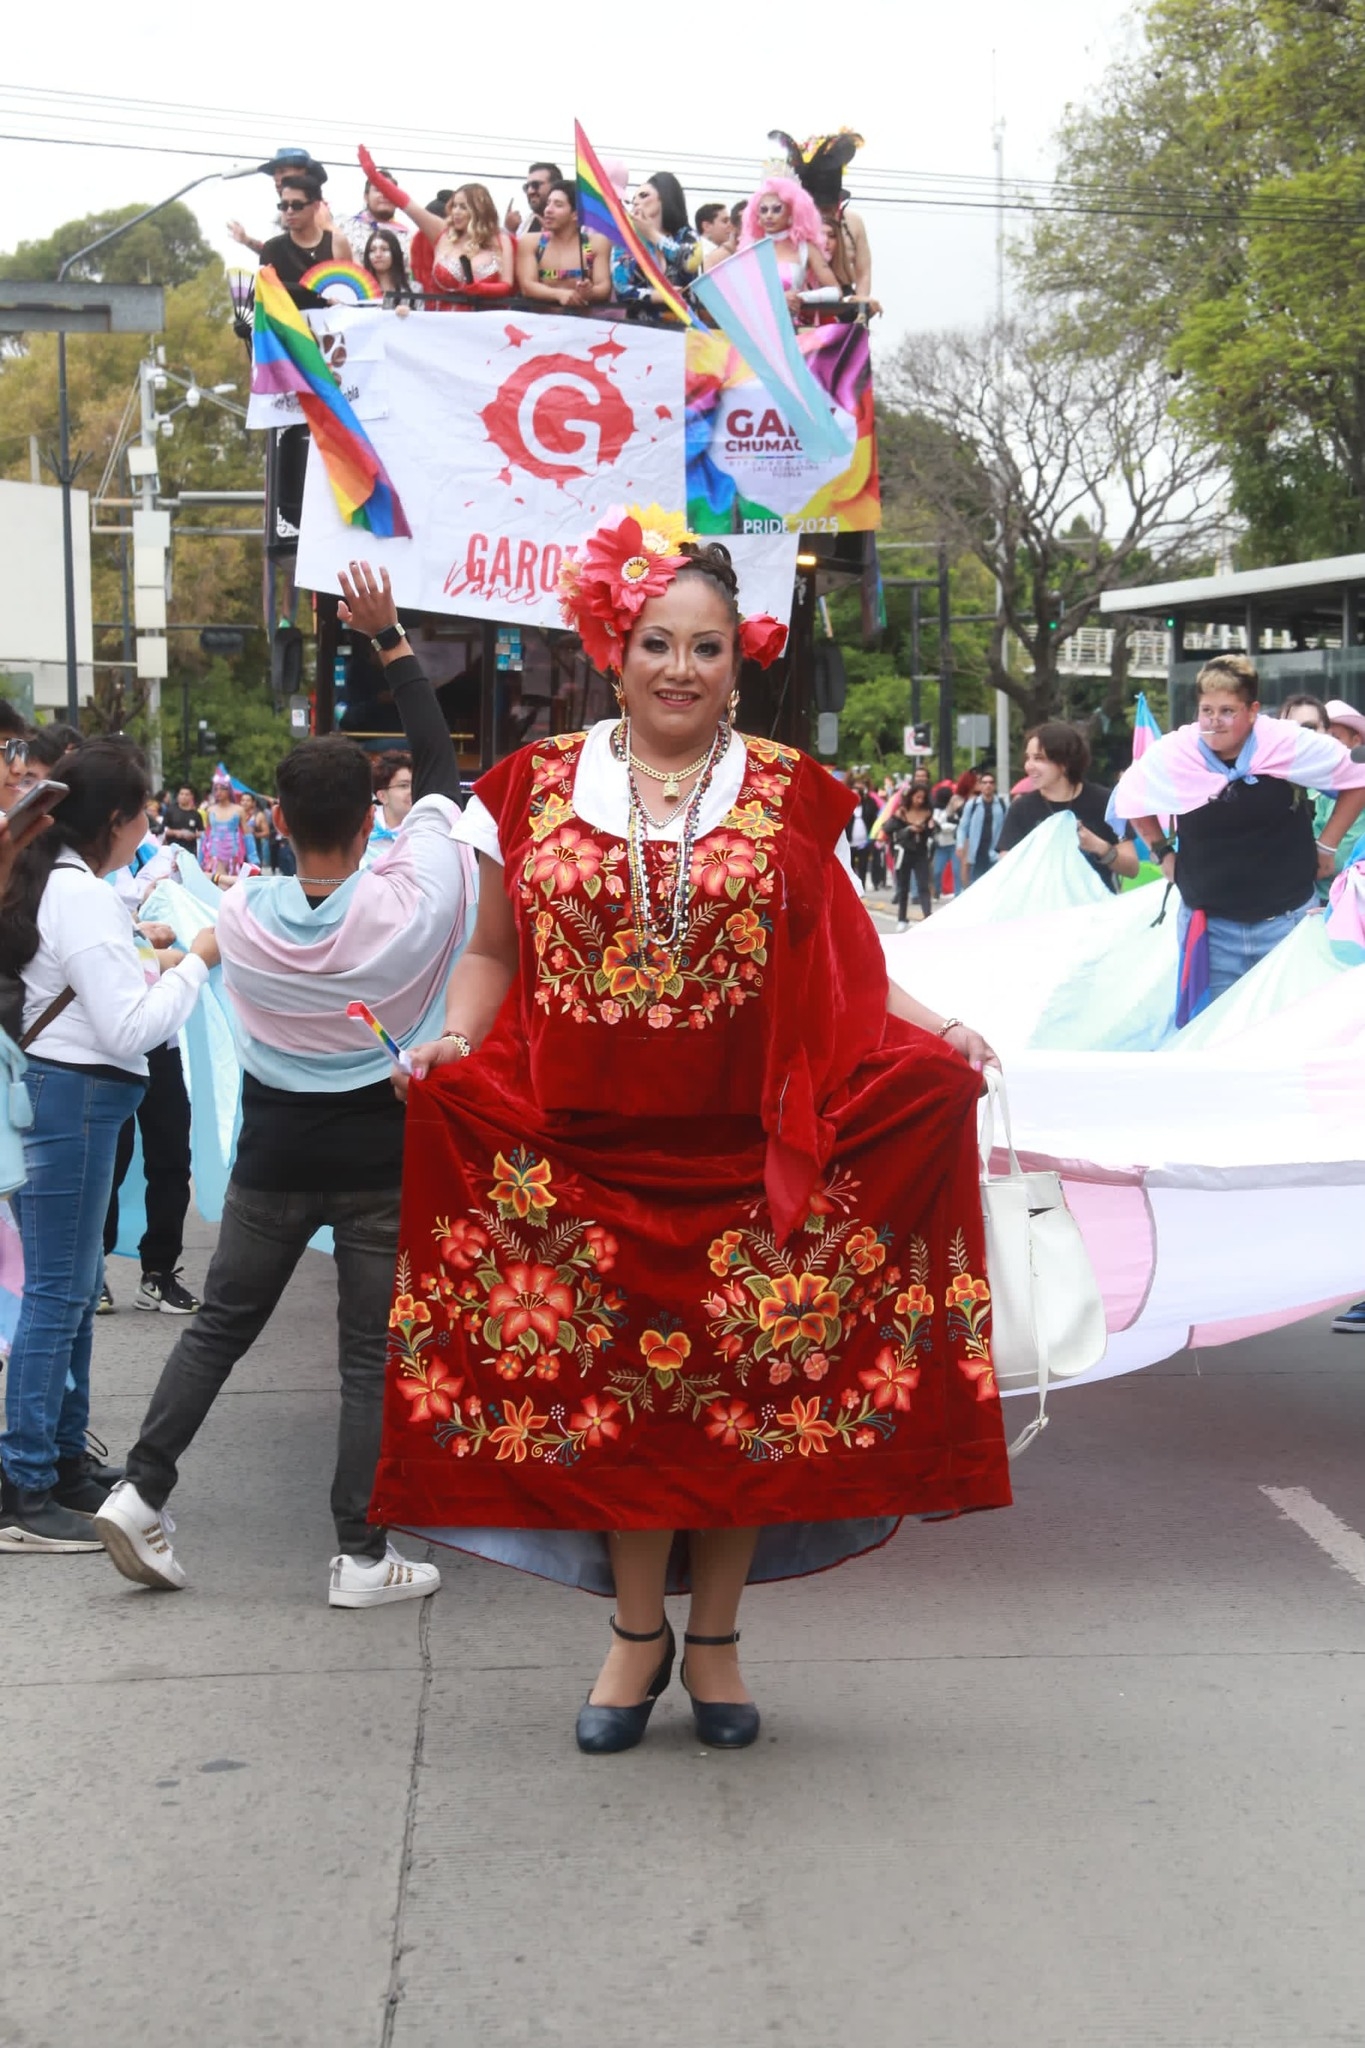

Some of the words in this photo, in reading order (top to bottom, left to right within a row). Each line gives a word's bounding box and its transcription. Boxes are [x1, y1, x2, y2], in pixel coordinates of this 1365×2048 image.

[517, 371, 601, 476] G
[743, 518, 790, 534] PRIDE
[798, 516, 840, 534] 2025
[465, 532, 578, 593] GARO
